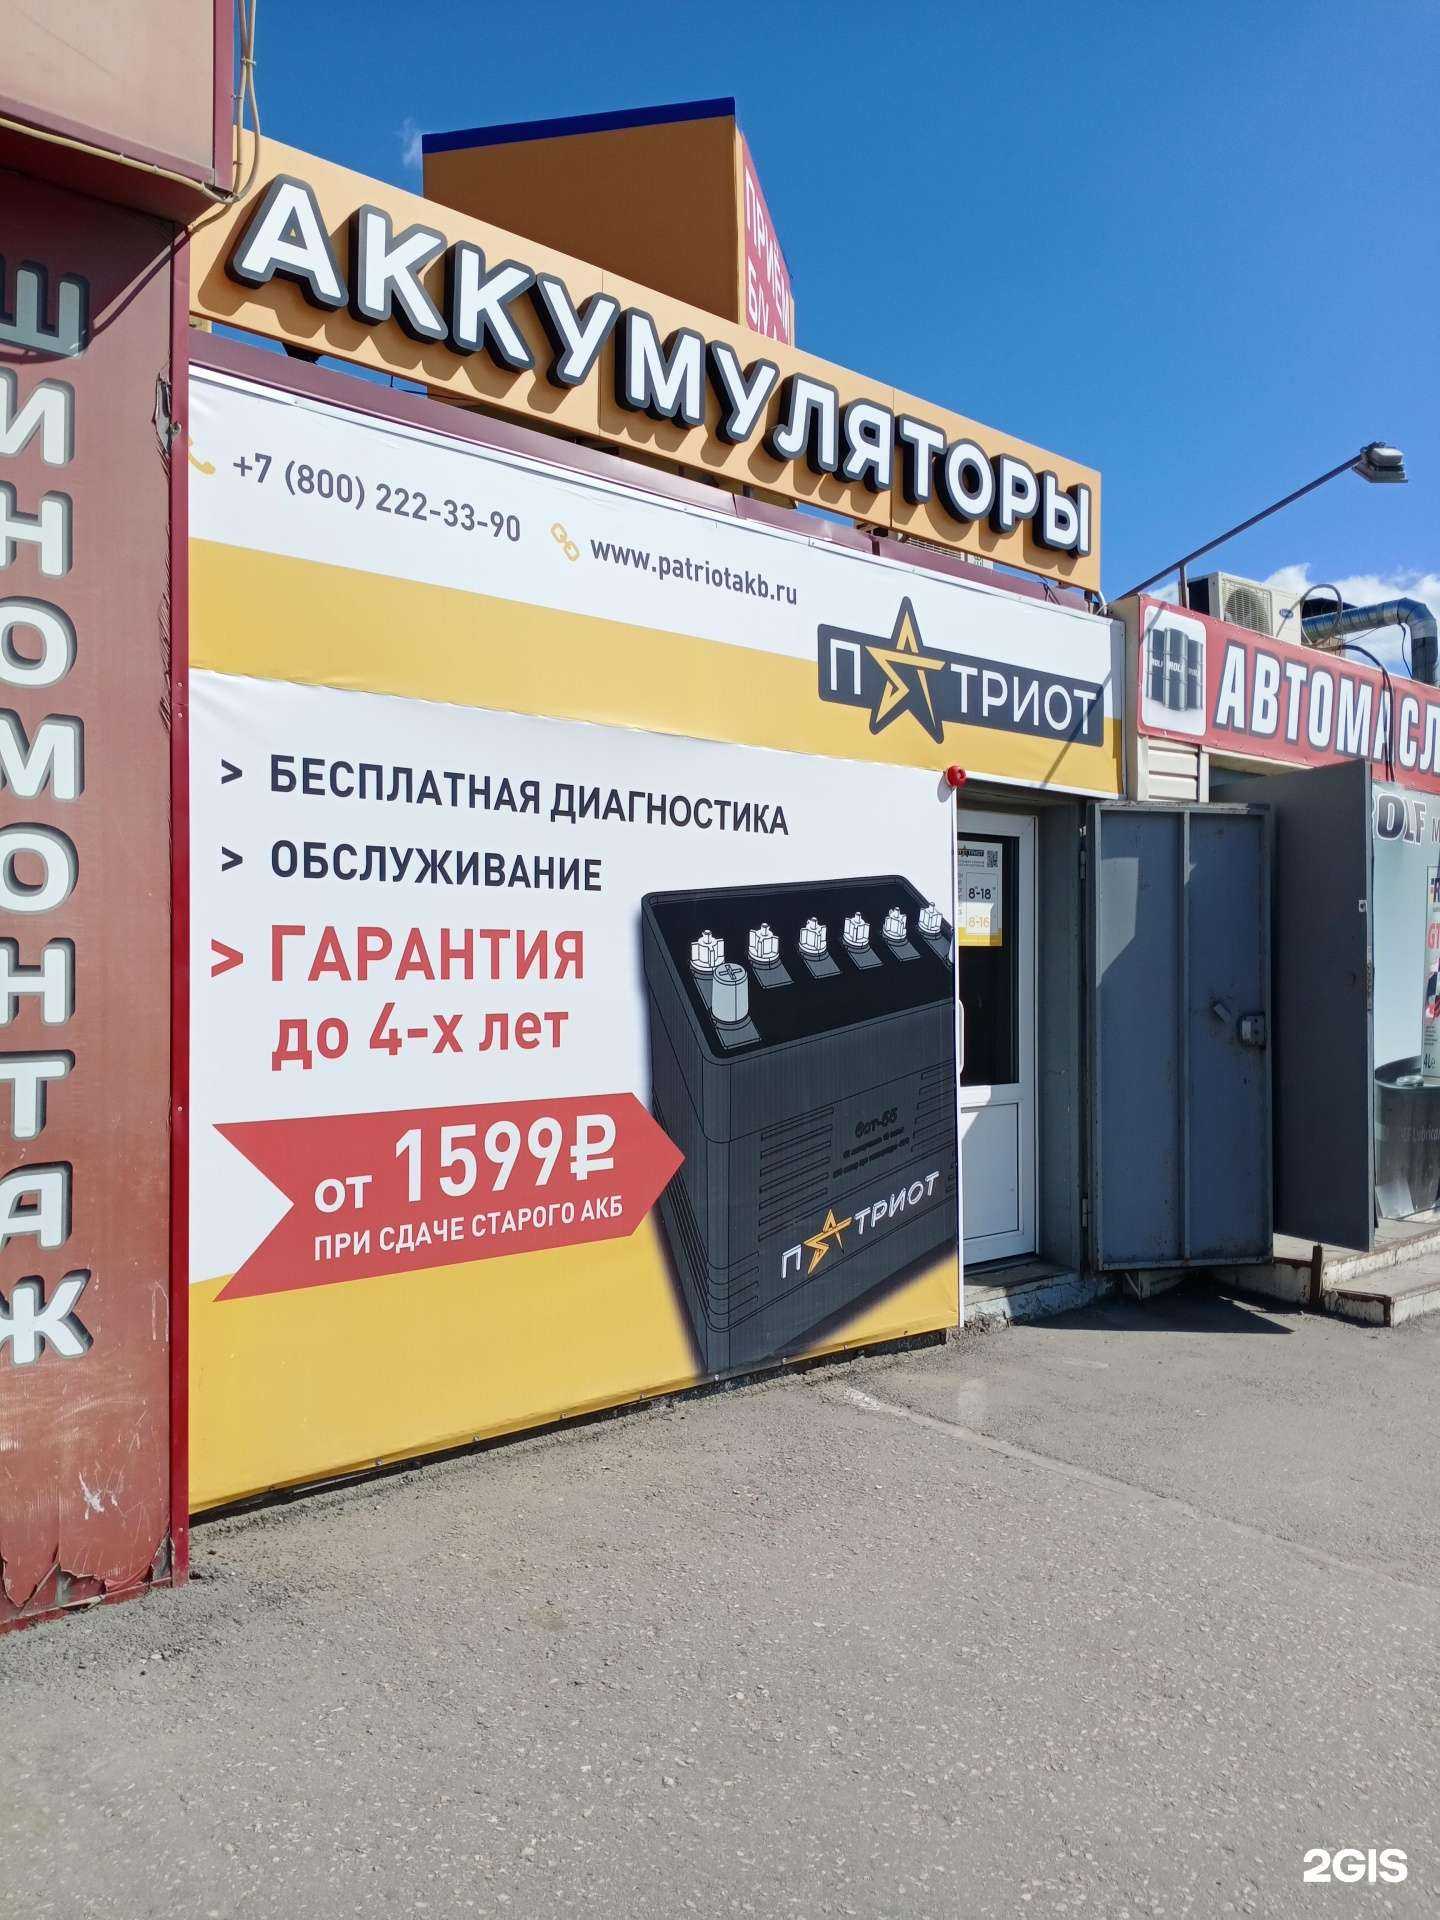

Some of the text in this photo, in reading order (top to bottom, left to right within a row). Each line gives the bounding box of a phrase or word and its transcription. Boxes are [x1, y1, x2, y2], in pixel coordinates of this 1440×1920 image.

[229, 174, 1093, 556] АККУМУЛЯТОРЫ
[233, 452, 521, 542] +7 (800) 222-33-90
[590, 539, 797, 605] www.patriotakb.ru
[270, 754, 789, 836] БЕСПЛАТНАЯ ДИАГНОСТИКА
[271, 839, 602, 892] ОБСЛУЖИВАНИЕ
[271, 924, 584, 982] ГАРАНТИЯ
[271, 1002, 569, 1071] до 4-х лет
[314, 1114, 618, 1214] от 1599₽
[314, 1195, 623, 1261] ПРИ СДАЧЕ СТАРОГО АКБ
